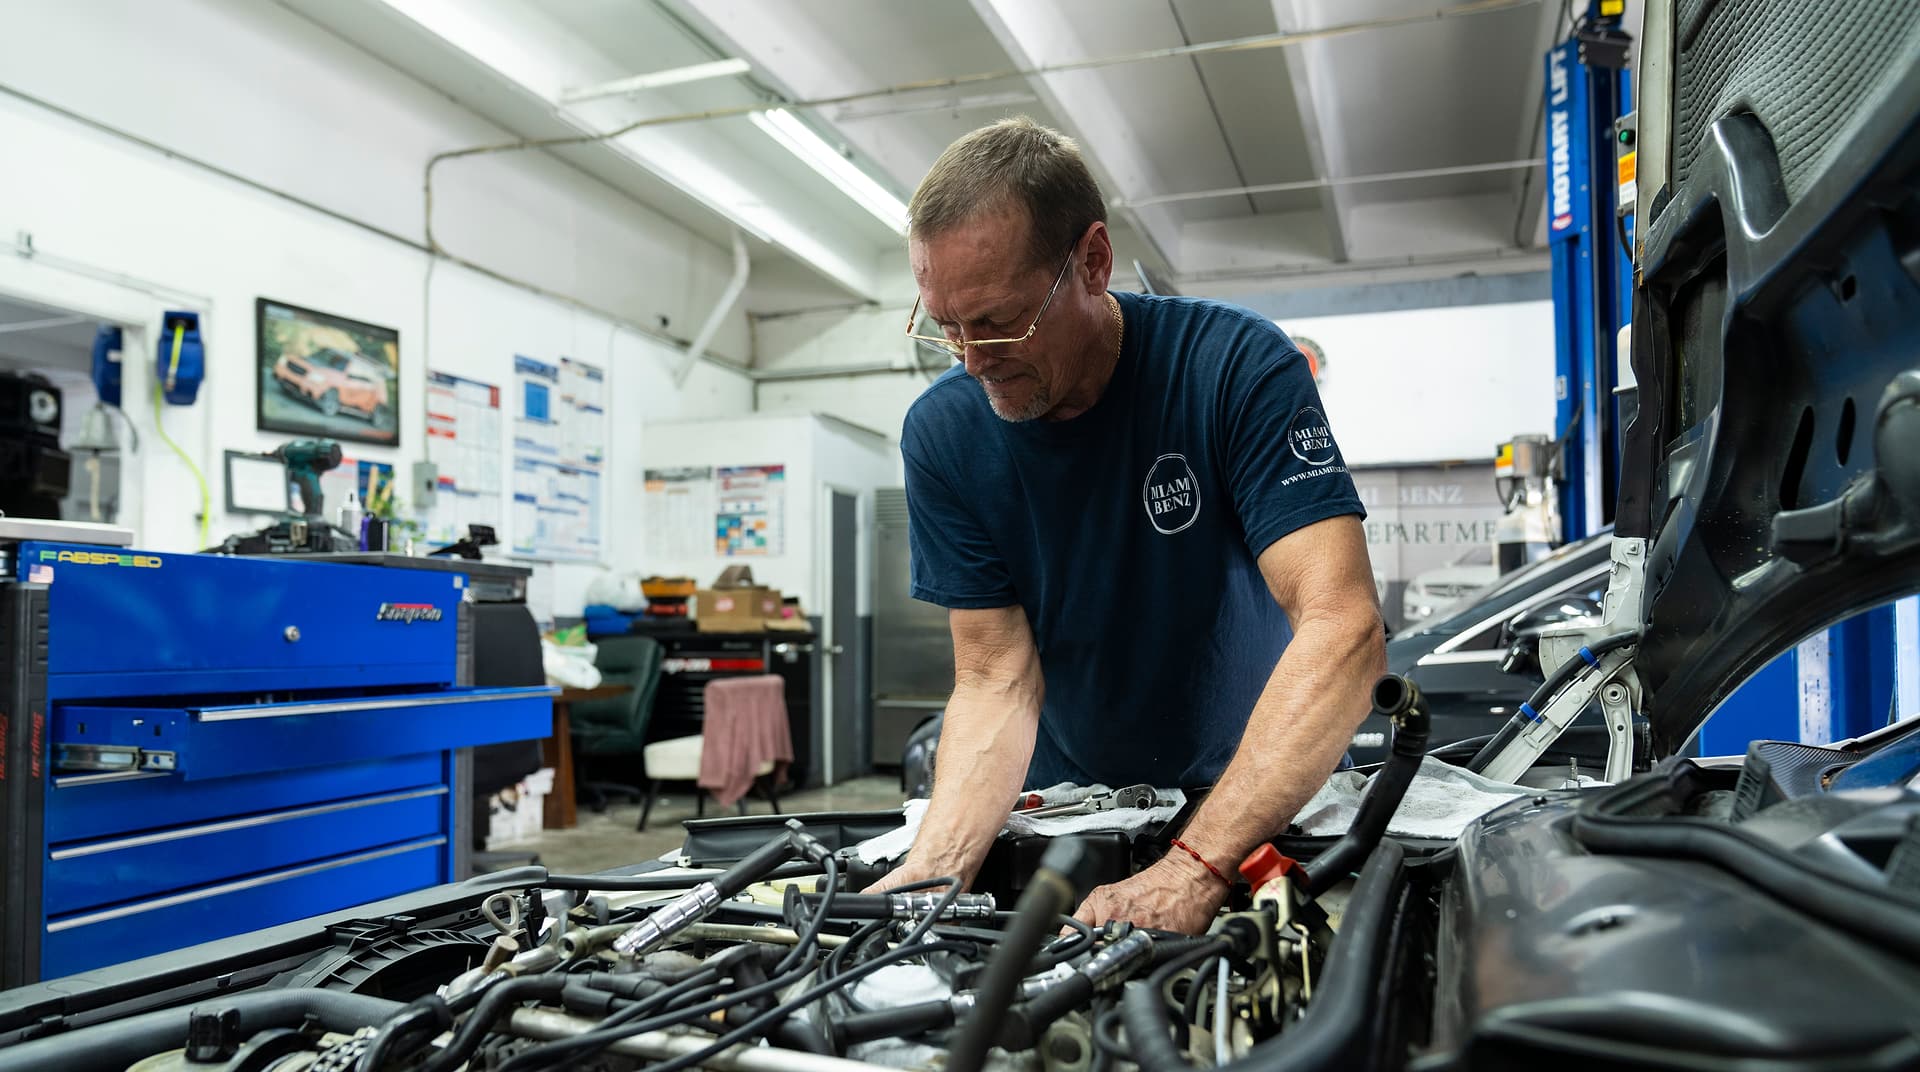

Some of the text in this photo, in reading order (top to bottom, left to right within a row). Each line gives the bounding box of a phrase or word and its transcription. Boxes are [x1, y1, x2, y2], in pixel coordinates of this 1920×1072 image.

[1550, 49, 1570, 216] ROTARY LIFT
[1294, 426, 1329, 442] MIAMI
[1302, 438, 1331, 451] BENZ
[1154, 492, 1191, 515] BENZ
[1367, 519, 1497, 545] EPARTME
[40, 550, 163, 568] FABSPEED
